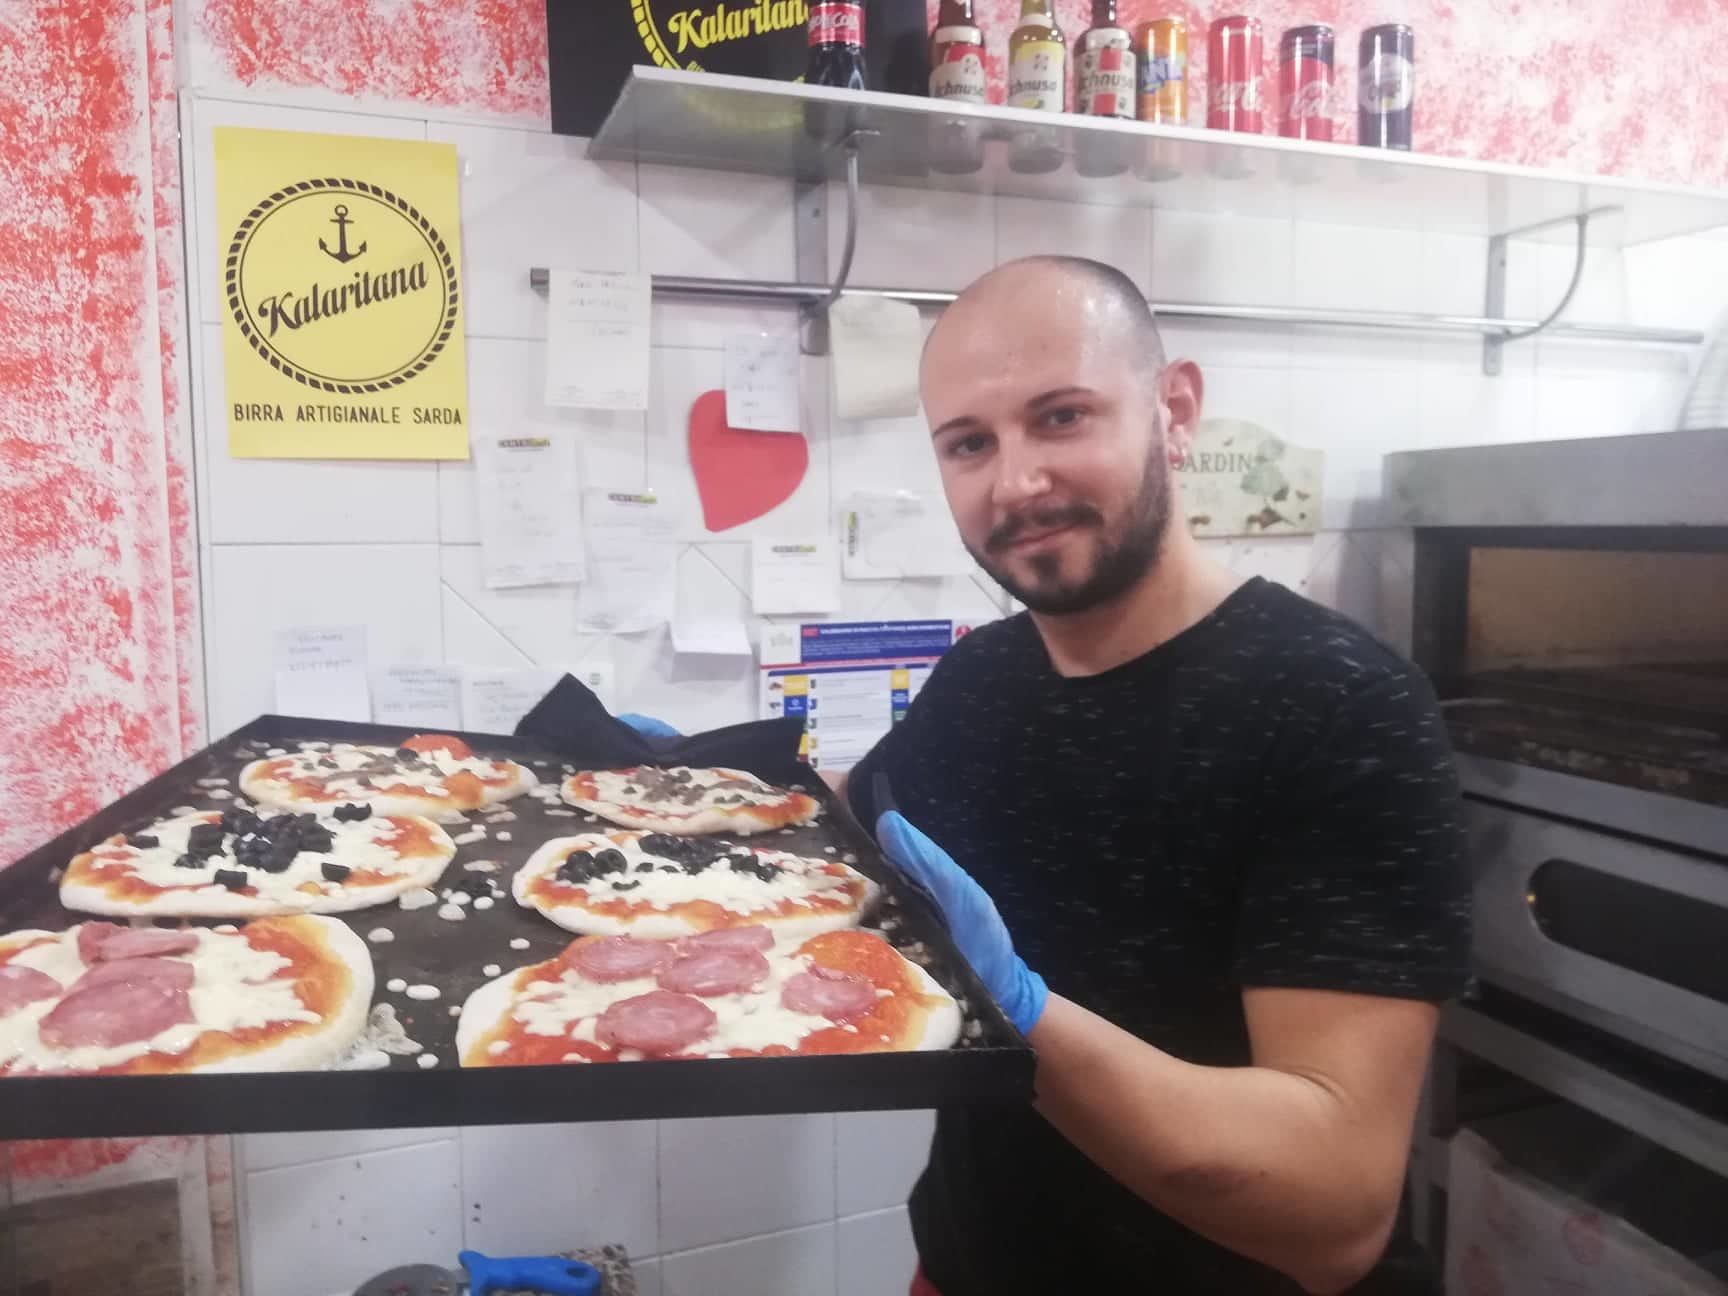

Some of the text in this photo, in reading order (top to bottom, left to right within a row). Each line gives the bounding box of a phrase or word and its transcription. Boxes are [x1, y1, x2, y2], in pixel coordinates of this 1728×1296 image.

[257, 261, 429, 338] Kalaritana
[233, 402, 463, 426] BIRRA ARTIGIANALE SARDA
